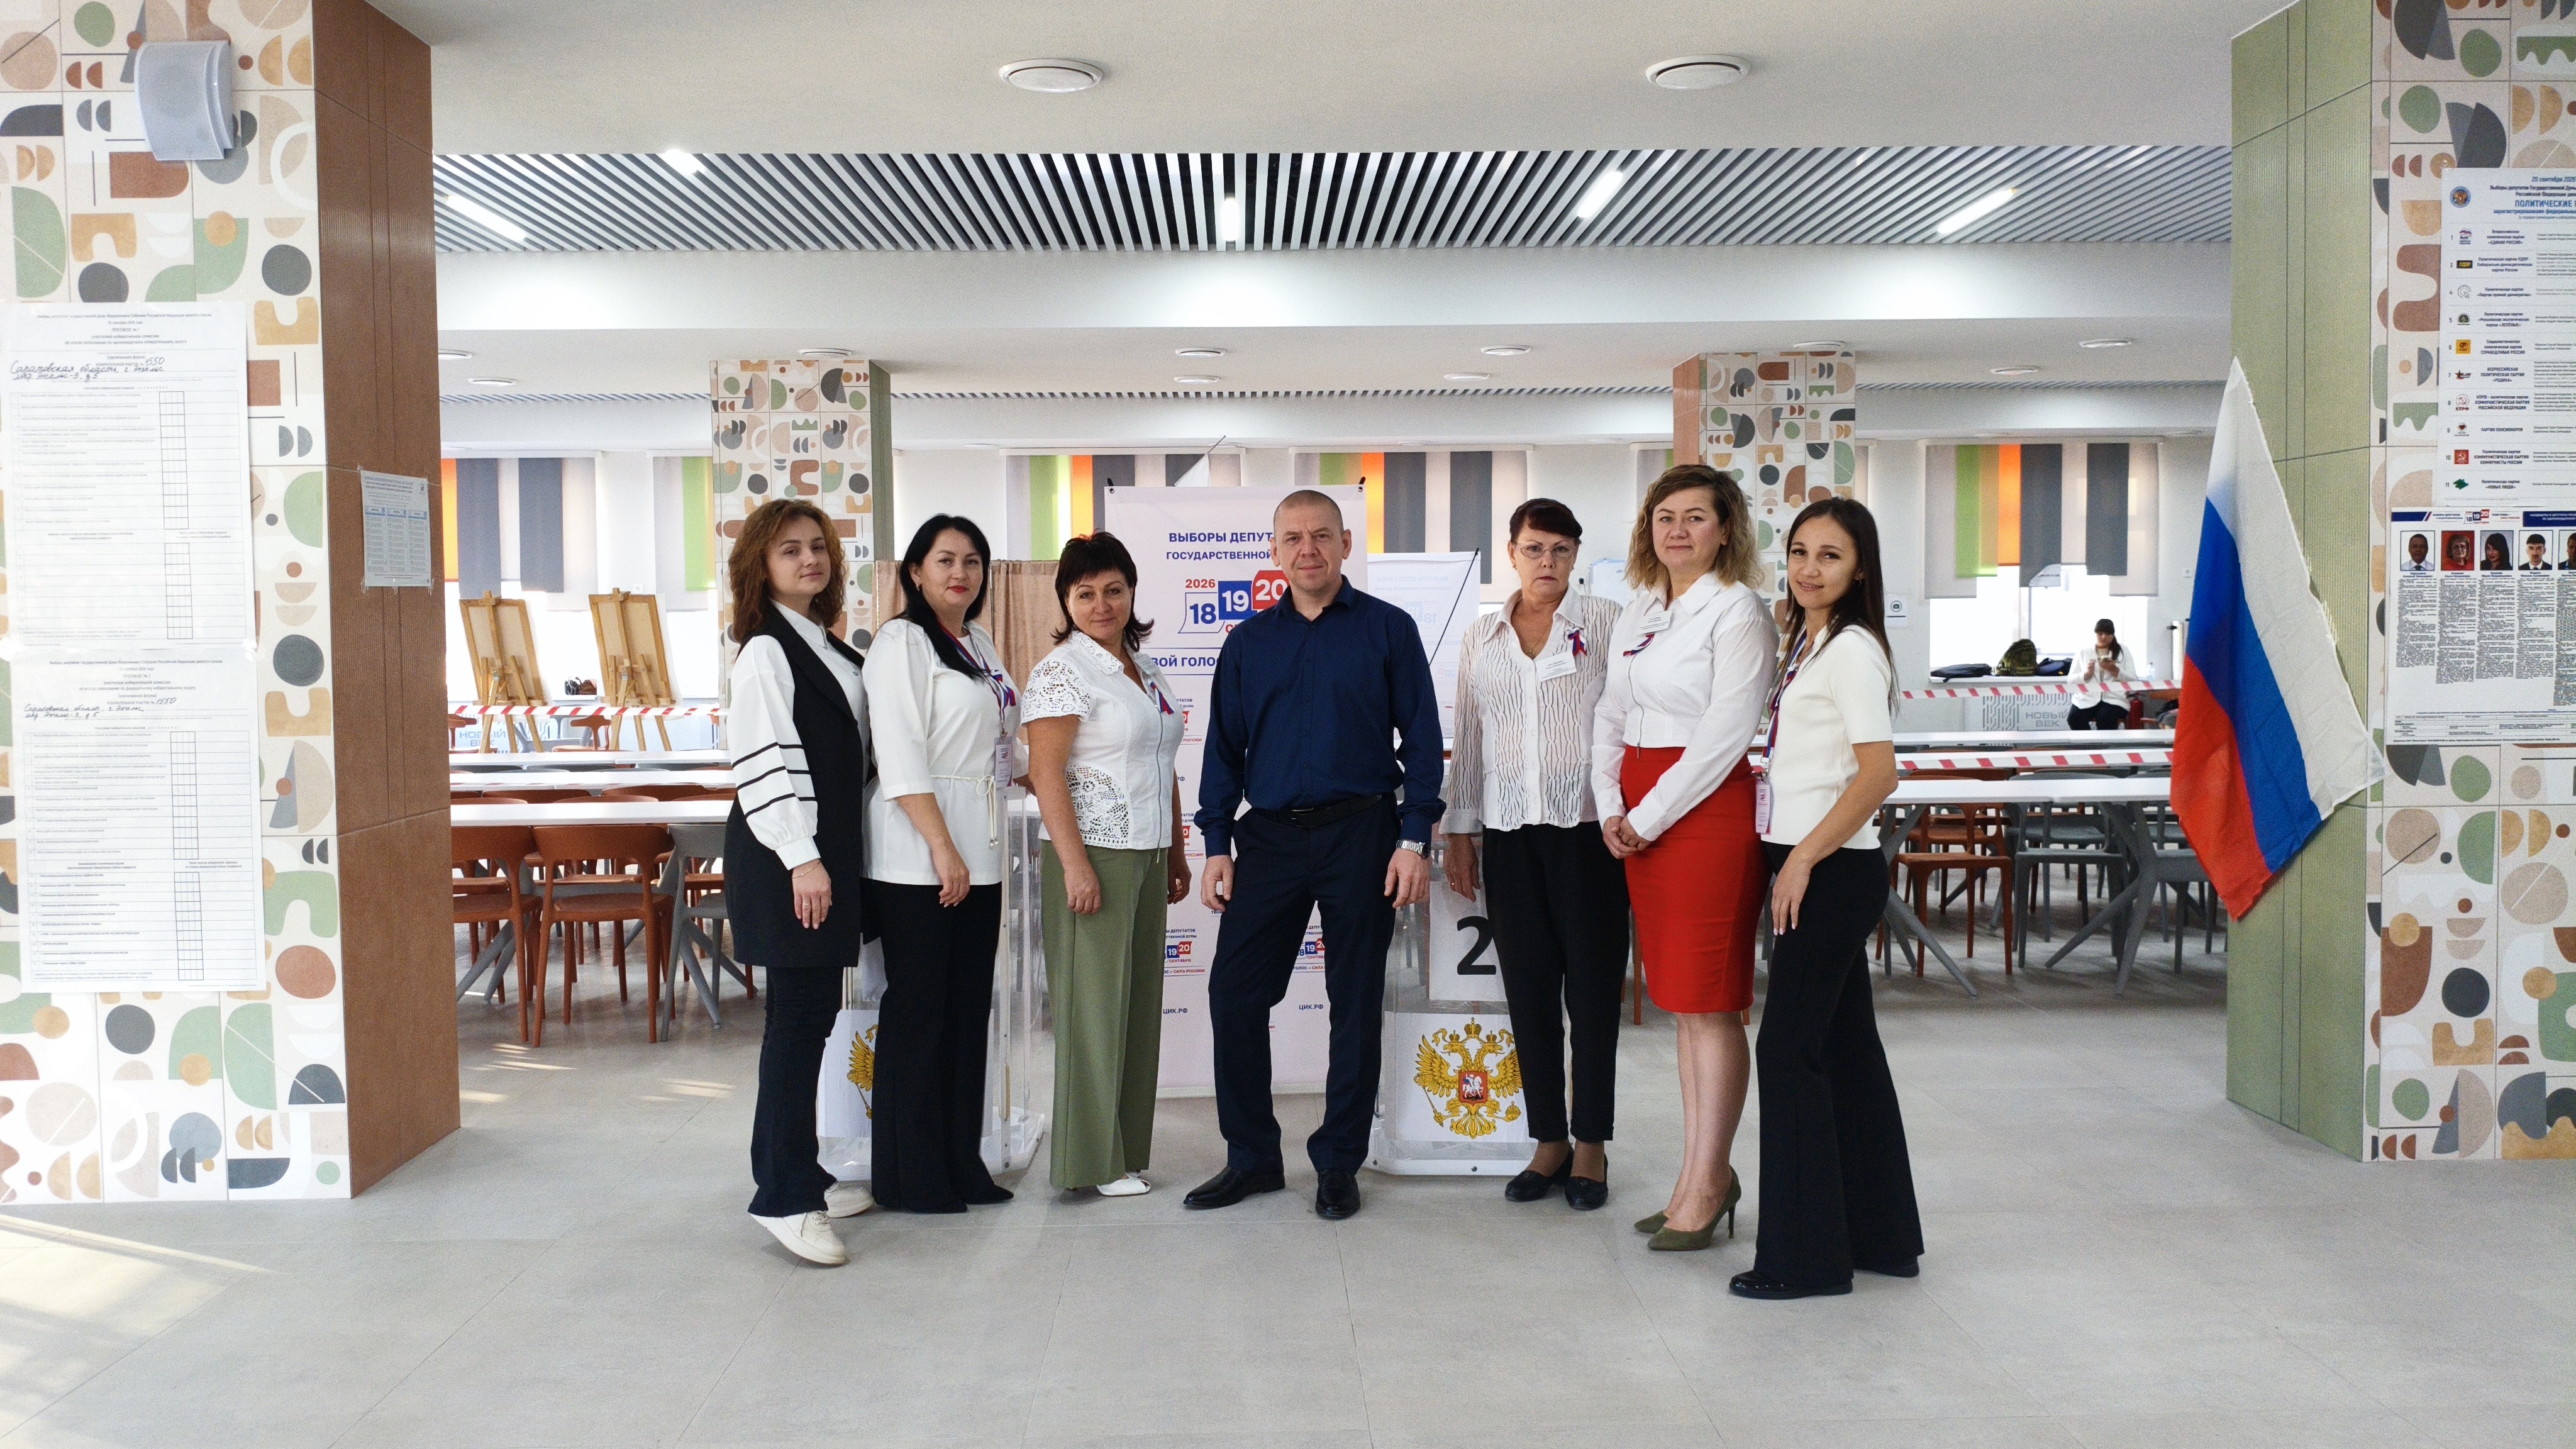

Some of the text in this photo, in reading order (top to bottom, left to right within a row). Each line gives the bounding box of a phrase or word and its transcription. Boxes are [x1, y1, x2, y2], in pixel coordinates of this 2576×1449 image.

[145, 357, 165, 366] 1550
[1169, 532, 1274, 544] ВЫБОРЫ ДЕПУТ
[1166, 549, 1271, 561] ГОСУДАРСТВЕННОЙ
[1185, 579, 1216, 589] 2026
[1255, 579, 1288, 601] 20
[1221, 590, 1250, 612] 19
[1189, 602, 1217, 625] 18
[1151, 655, 1177, 667] ВОЙ
[156, 697, 177, 705] 1550
[2026, 709, 2068, 719] НОВЫЙ
[2035, 719, 2060, 728] ВЕК
[459, 728, 506, 739] НОВЙ
[1179, 944, 1190, 952] 20
[1306, 944, 1316, 952] 19
[1456, 915, 1497, 975] 2
[1167, 948, 1177, 956] 19
